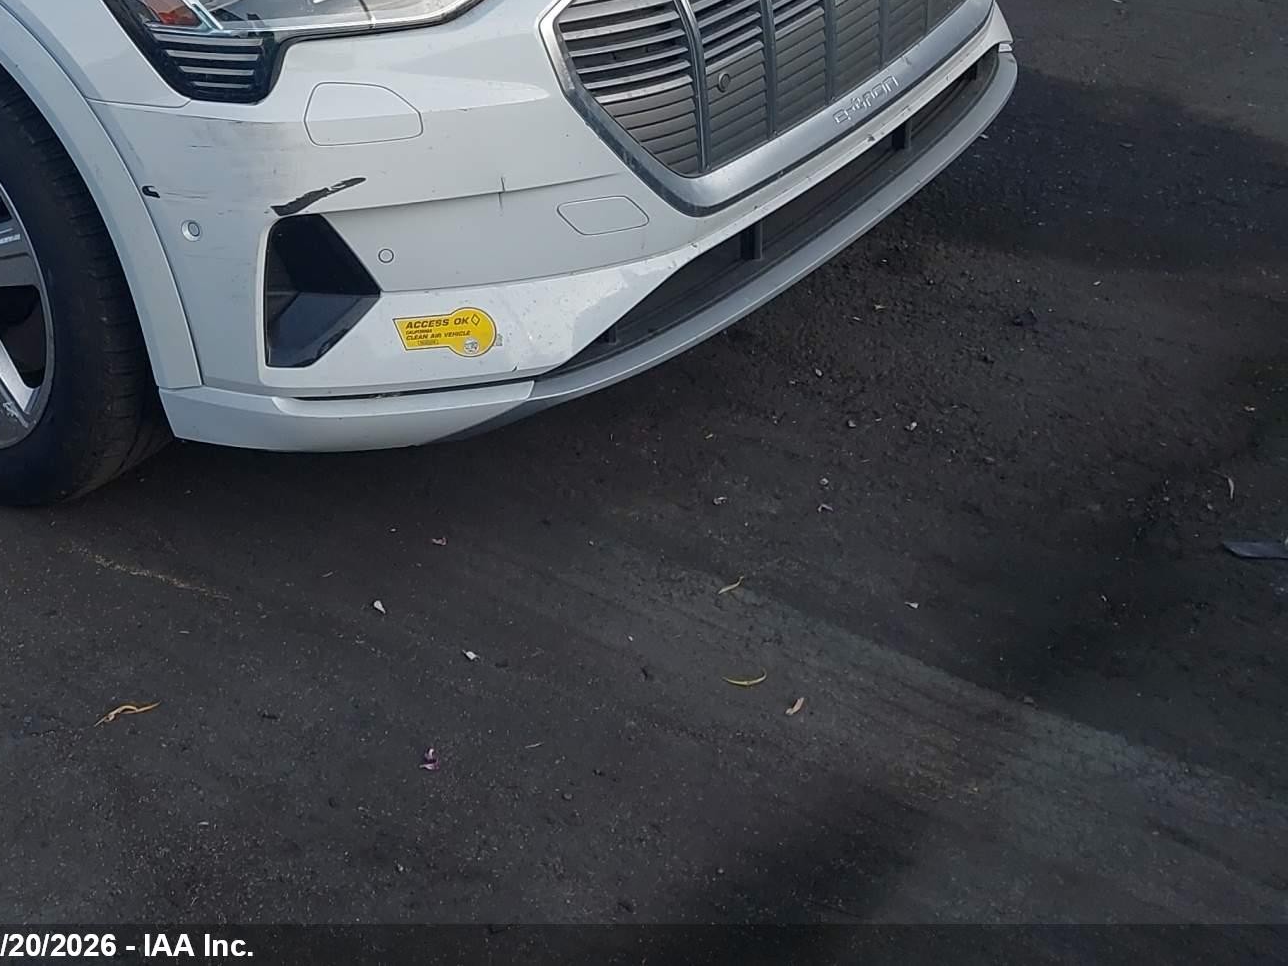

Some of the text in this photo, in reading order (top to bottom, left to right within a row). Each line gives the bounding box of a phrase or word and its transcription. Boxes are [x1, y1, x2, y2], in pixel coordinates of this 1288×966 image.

[405, 316, 471, 329] ACCESS OK
[444, 330, 471, 338] VEHICLE
